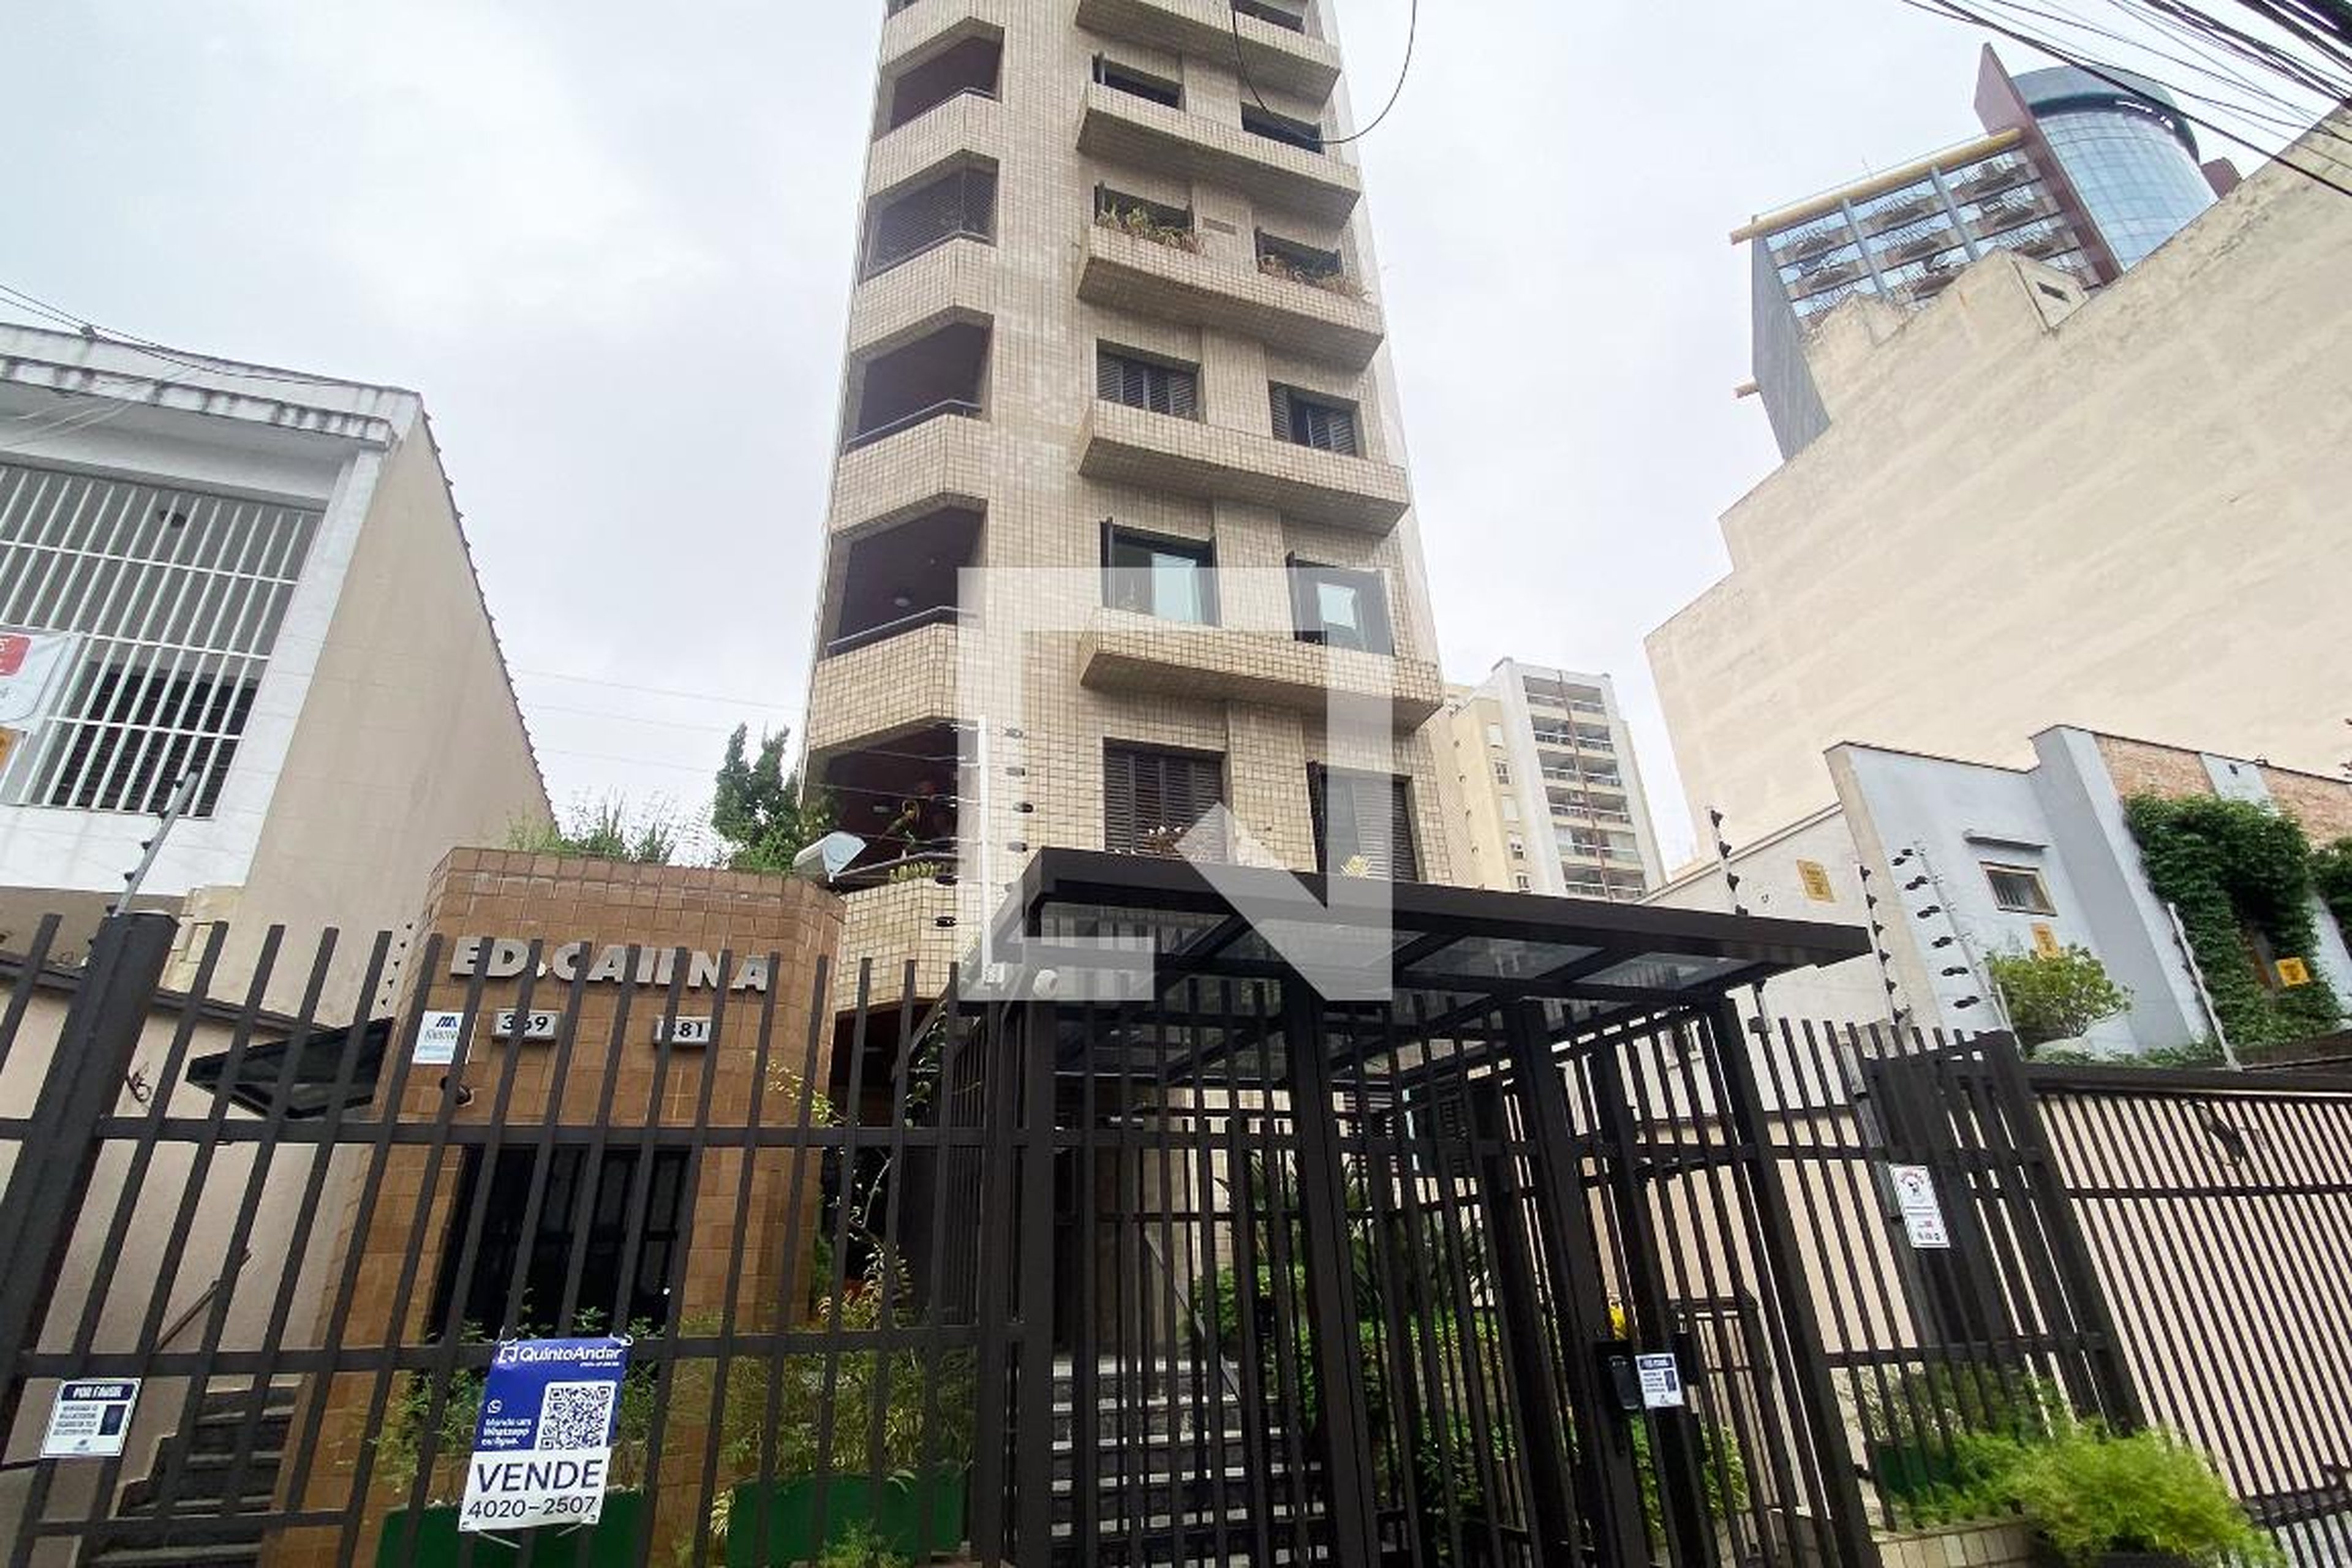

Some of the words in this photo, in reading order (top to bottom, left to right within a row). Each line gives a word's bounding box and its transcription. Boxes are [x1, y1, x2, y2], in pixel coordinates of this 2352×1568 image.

[664, 1022, 703, 1038] 81
[519, 1346, 623, 1362] QuintoAndar
[477, 1459, 603, 1493] VENDE
[467, 1496, 597, 1518] 4020-2507
